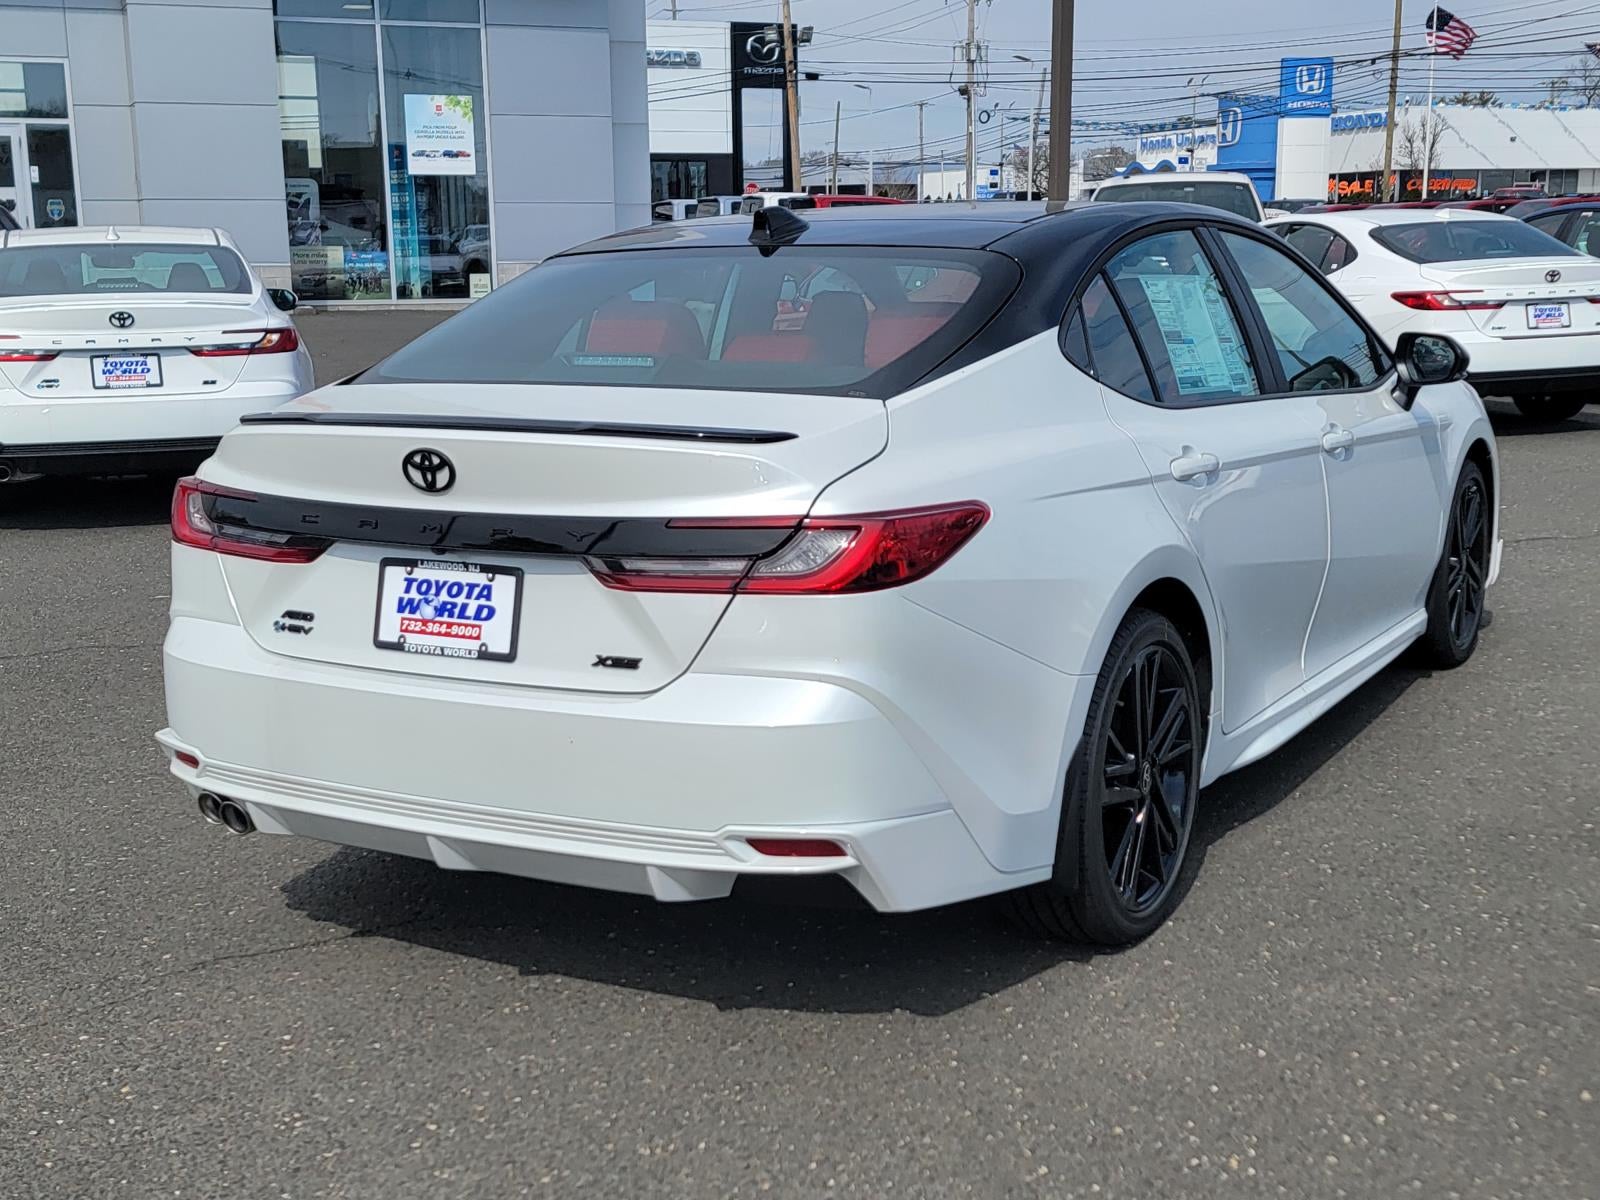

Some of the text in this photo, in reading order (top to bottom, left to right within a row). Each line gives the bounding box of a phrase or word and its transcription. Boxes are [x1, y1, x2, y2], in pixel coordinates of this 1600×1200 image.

[1287, 100, 1330, 108] HONDA
[1140, 135, 1173, 151] Honda
[1338, 180, 1374, 194] SALE
[103, 360, 148, 368] TOYOTA
[301, 513, 597, 542] CAMRY
[418, 560, 481, 573] LAKEWOOD, NJ
[403, 577, 493, 601] TOYOTA
[396, 595, 497, 621] WORLD
[402, 620, 480, 637] 732-364-9000
[404, 643, 479, 659] TOYOTA WORLD
